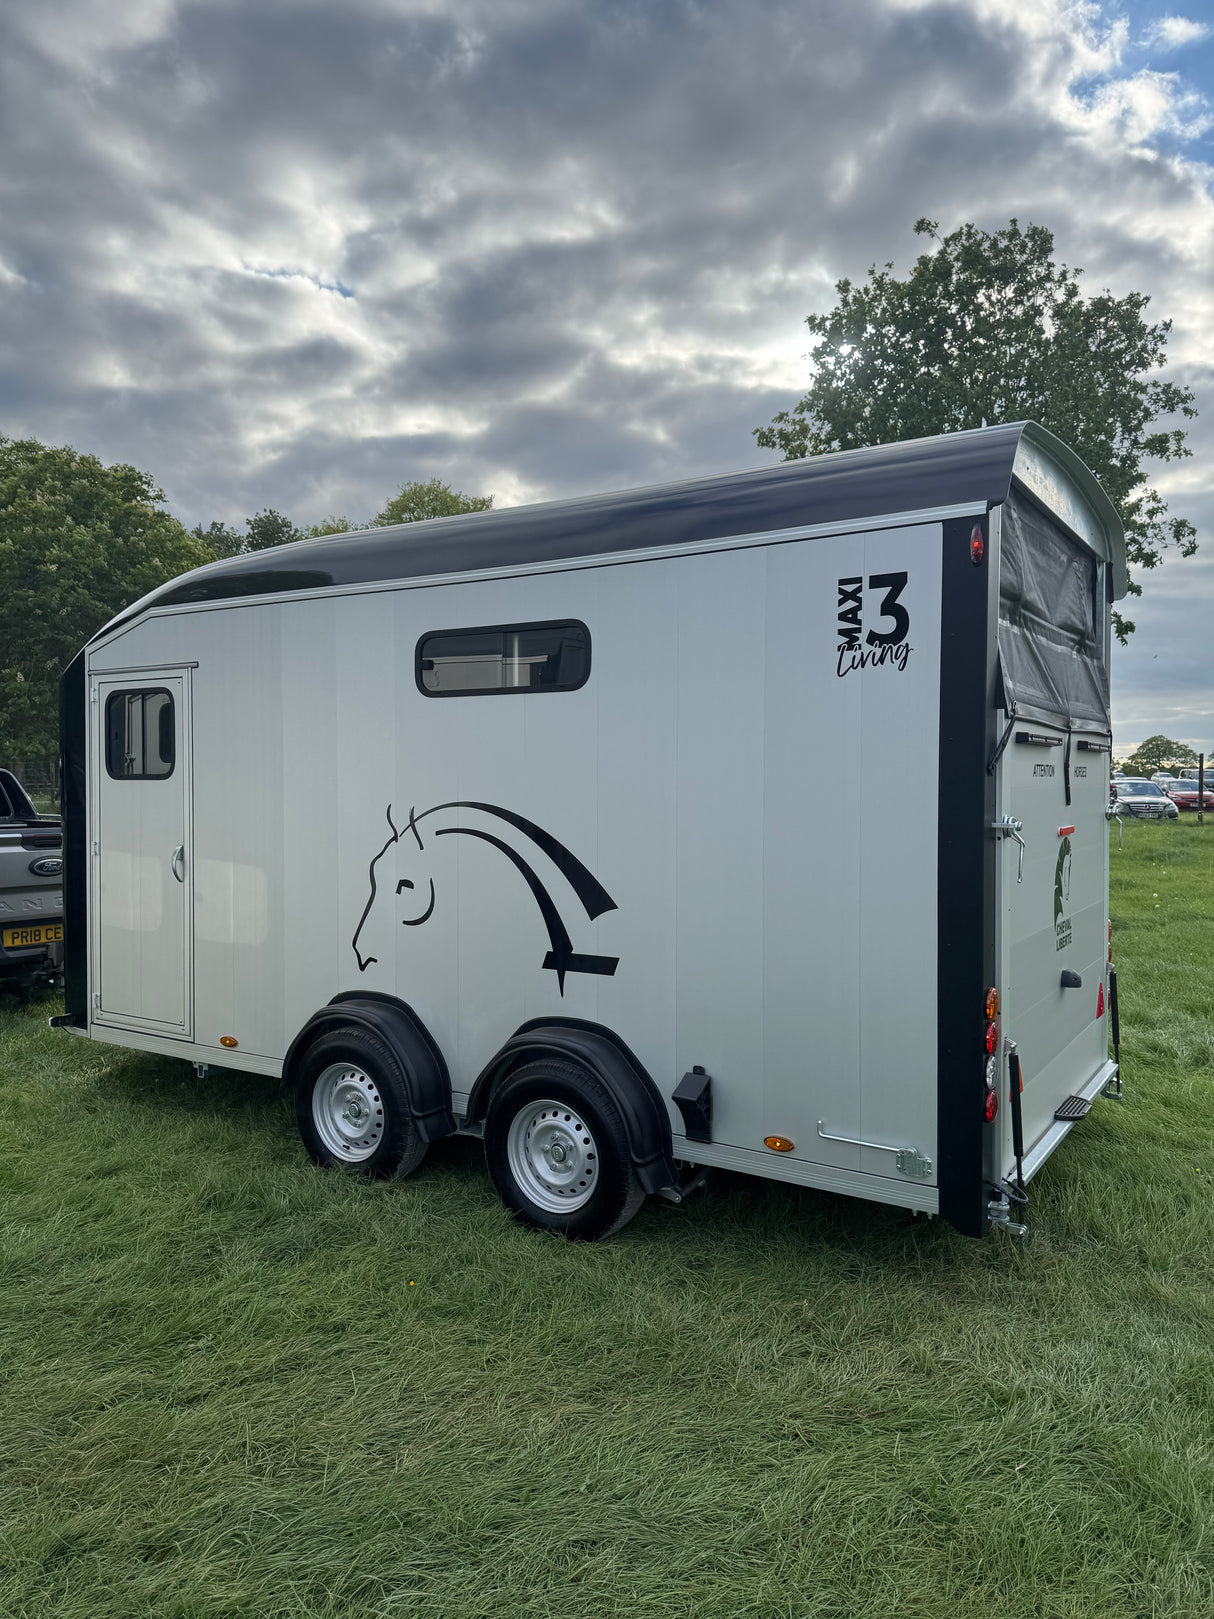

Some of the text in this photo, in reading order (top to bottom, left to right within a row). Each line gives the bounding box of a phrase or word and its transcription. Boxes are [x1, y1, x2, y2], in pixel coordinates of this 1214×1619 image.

[837, 576, 863, 652] MAXI
[865, 571, 910, 648] 3
[837, 642, 914, 677] Living
[1032, 764, 1087, 778] ATTENTION HORSES
[11, 929, 42, 945] PR18
[1056, 917, 1072, 936] CHEVAL
